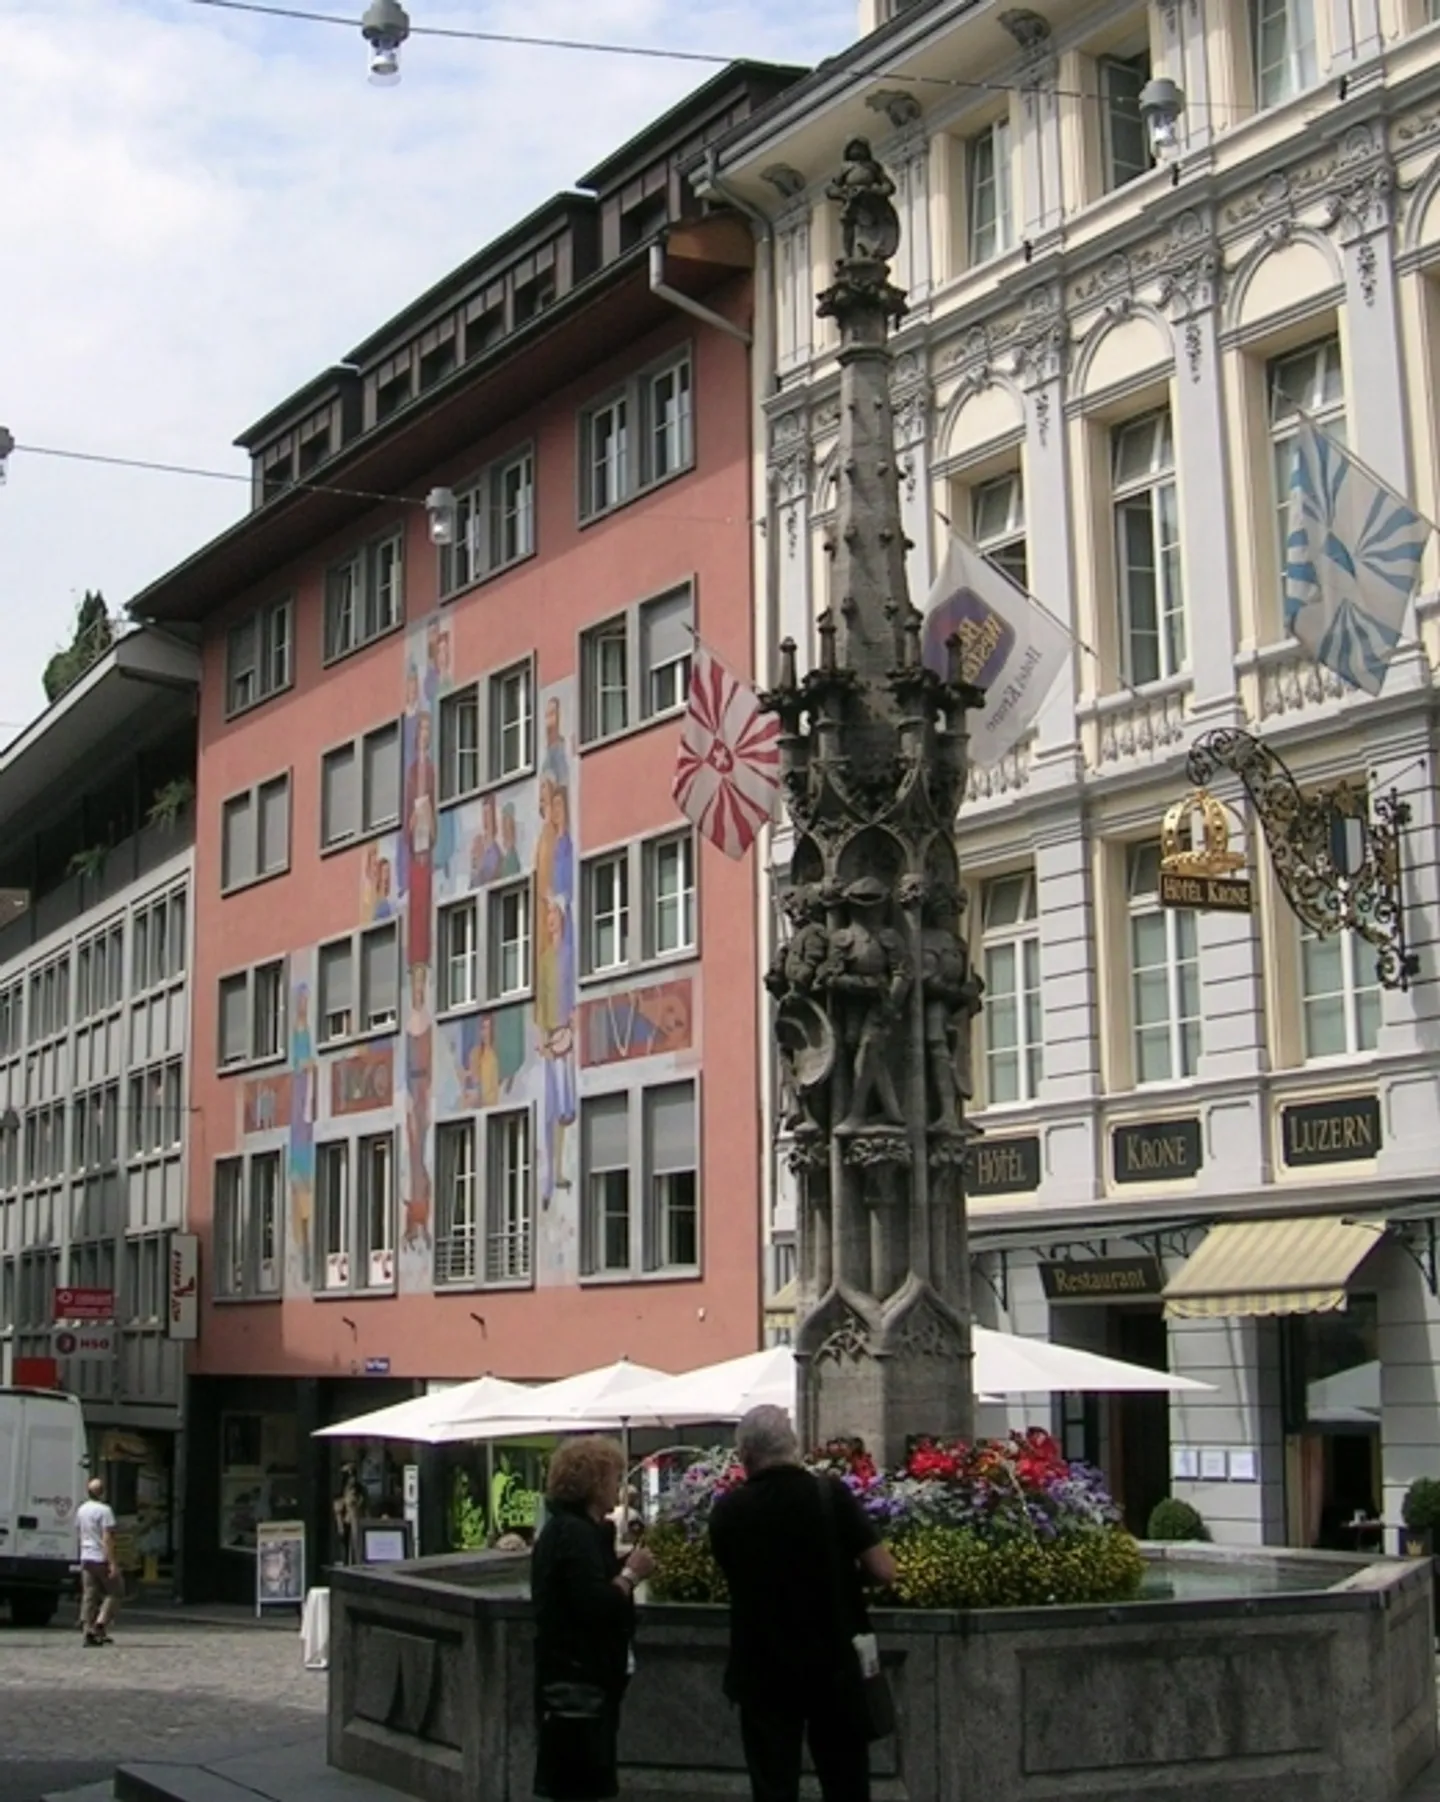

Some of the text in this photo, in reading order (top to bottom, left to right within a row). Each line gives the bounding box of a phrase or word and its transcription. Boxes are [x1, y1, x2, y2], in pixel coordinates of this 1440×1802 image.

[1126, 1134, 1188, 1171] KRONE
[1289, 1114, 1374, 1154] LUZERN
[1052, 1267, 1148, 1292] Restaurant
